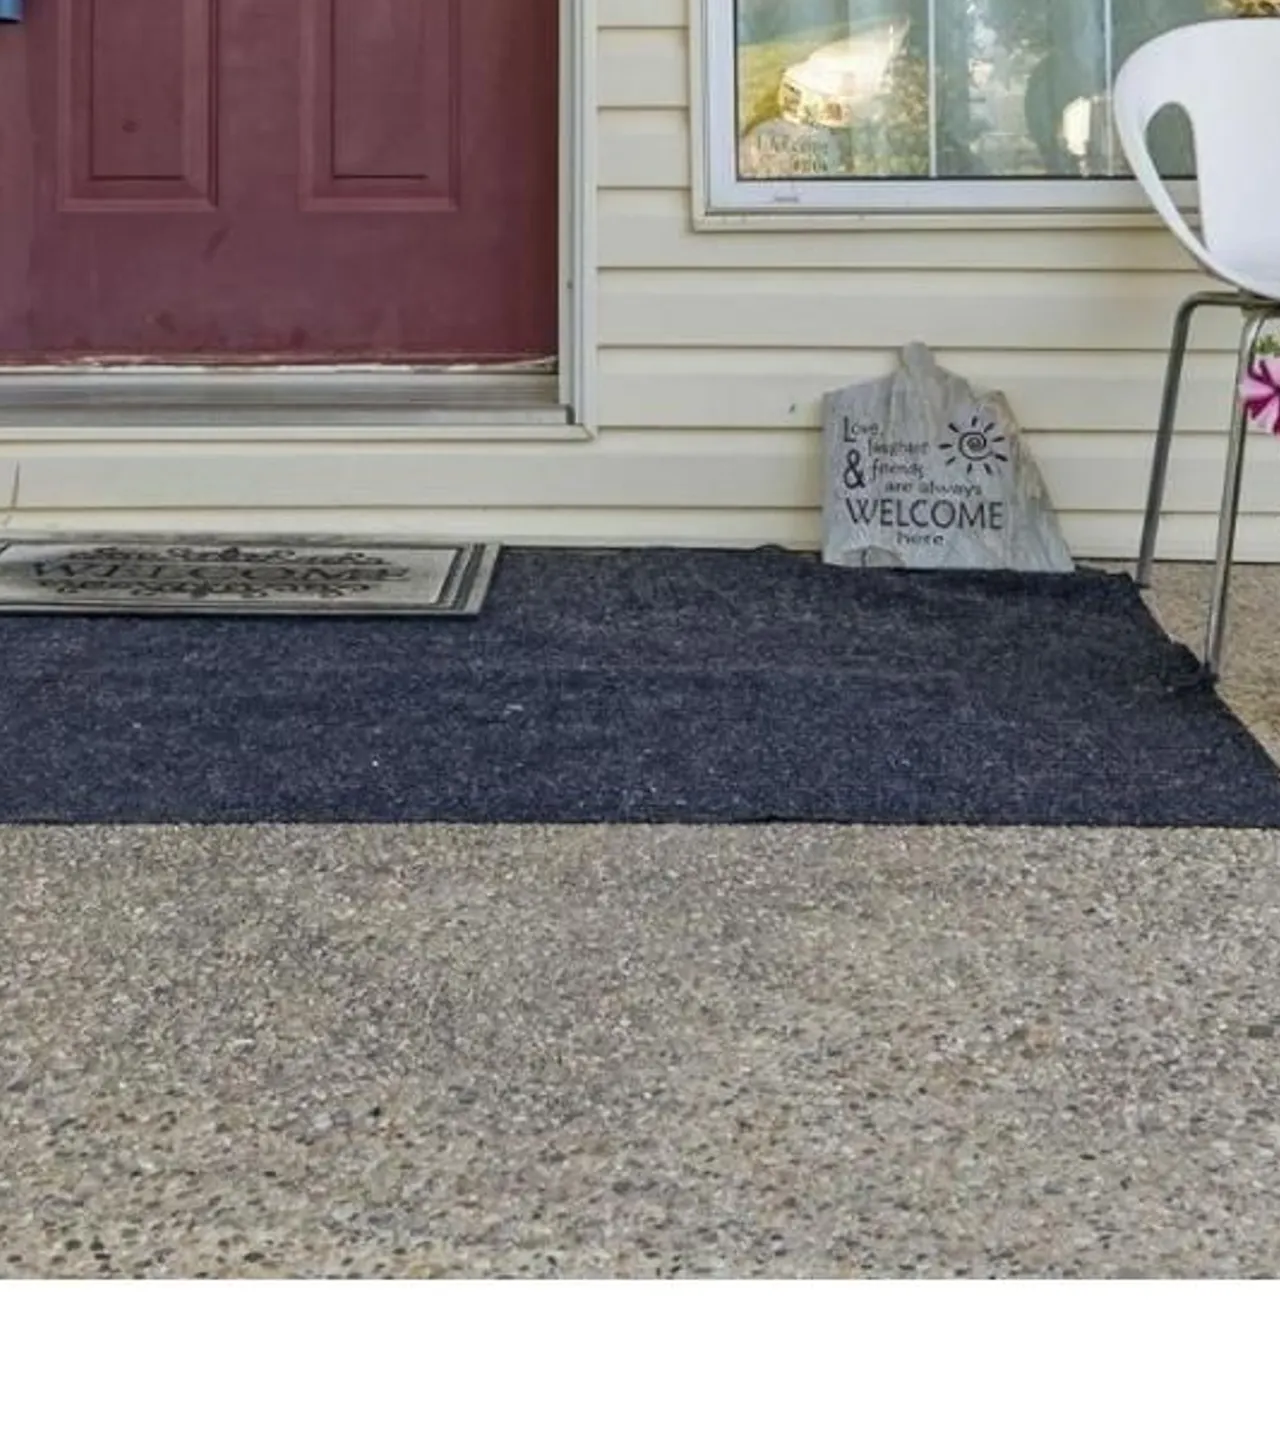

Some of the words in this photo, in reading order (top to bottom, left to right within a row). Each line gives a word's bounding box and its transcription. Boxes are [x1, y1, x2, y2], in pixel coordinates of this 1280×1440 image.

[843, 448, 865, 489] &
[872, 458, 924, 480] friends
[885, 481, 913, 493] are
[920, 481, 983, 497] always
[845, 497, 1004, 530] WELCOME
[896, 532, 945, 545] here
